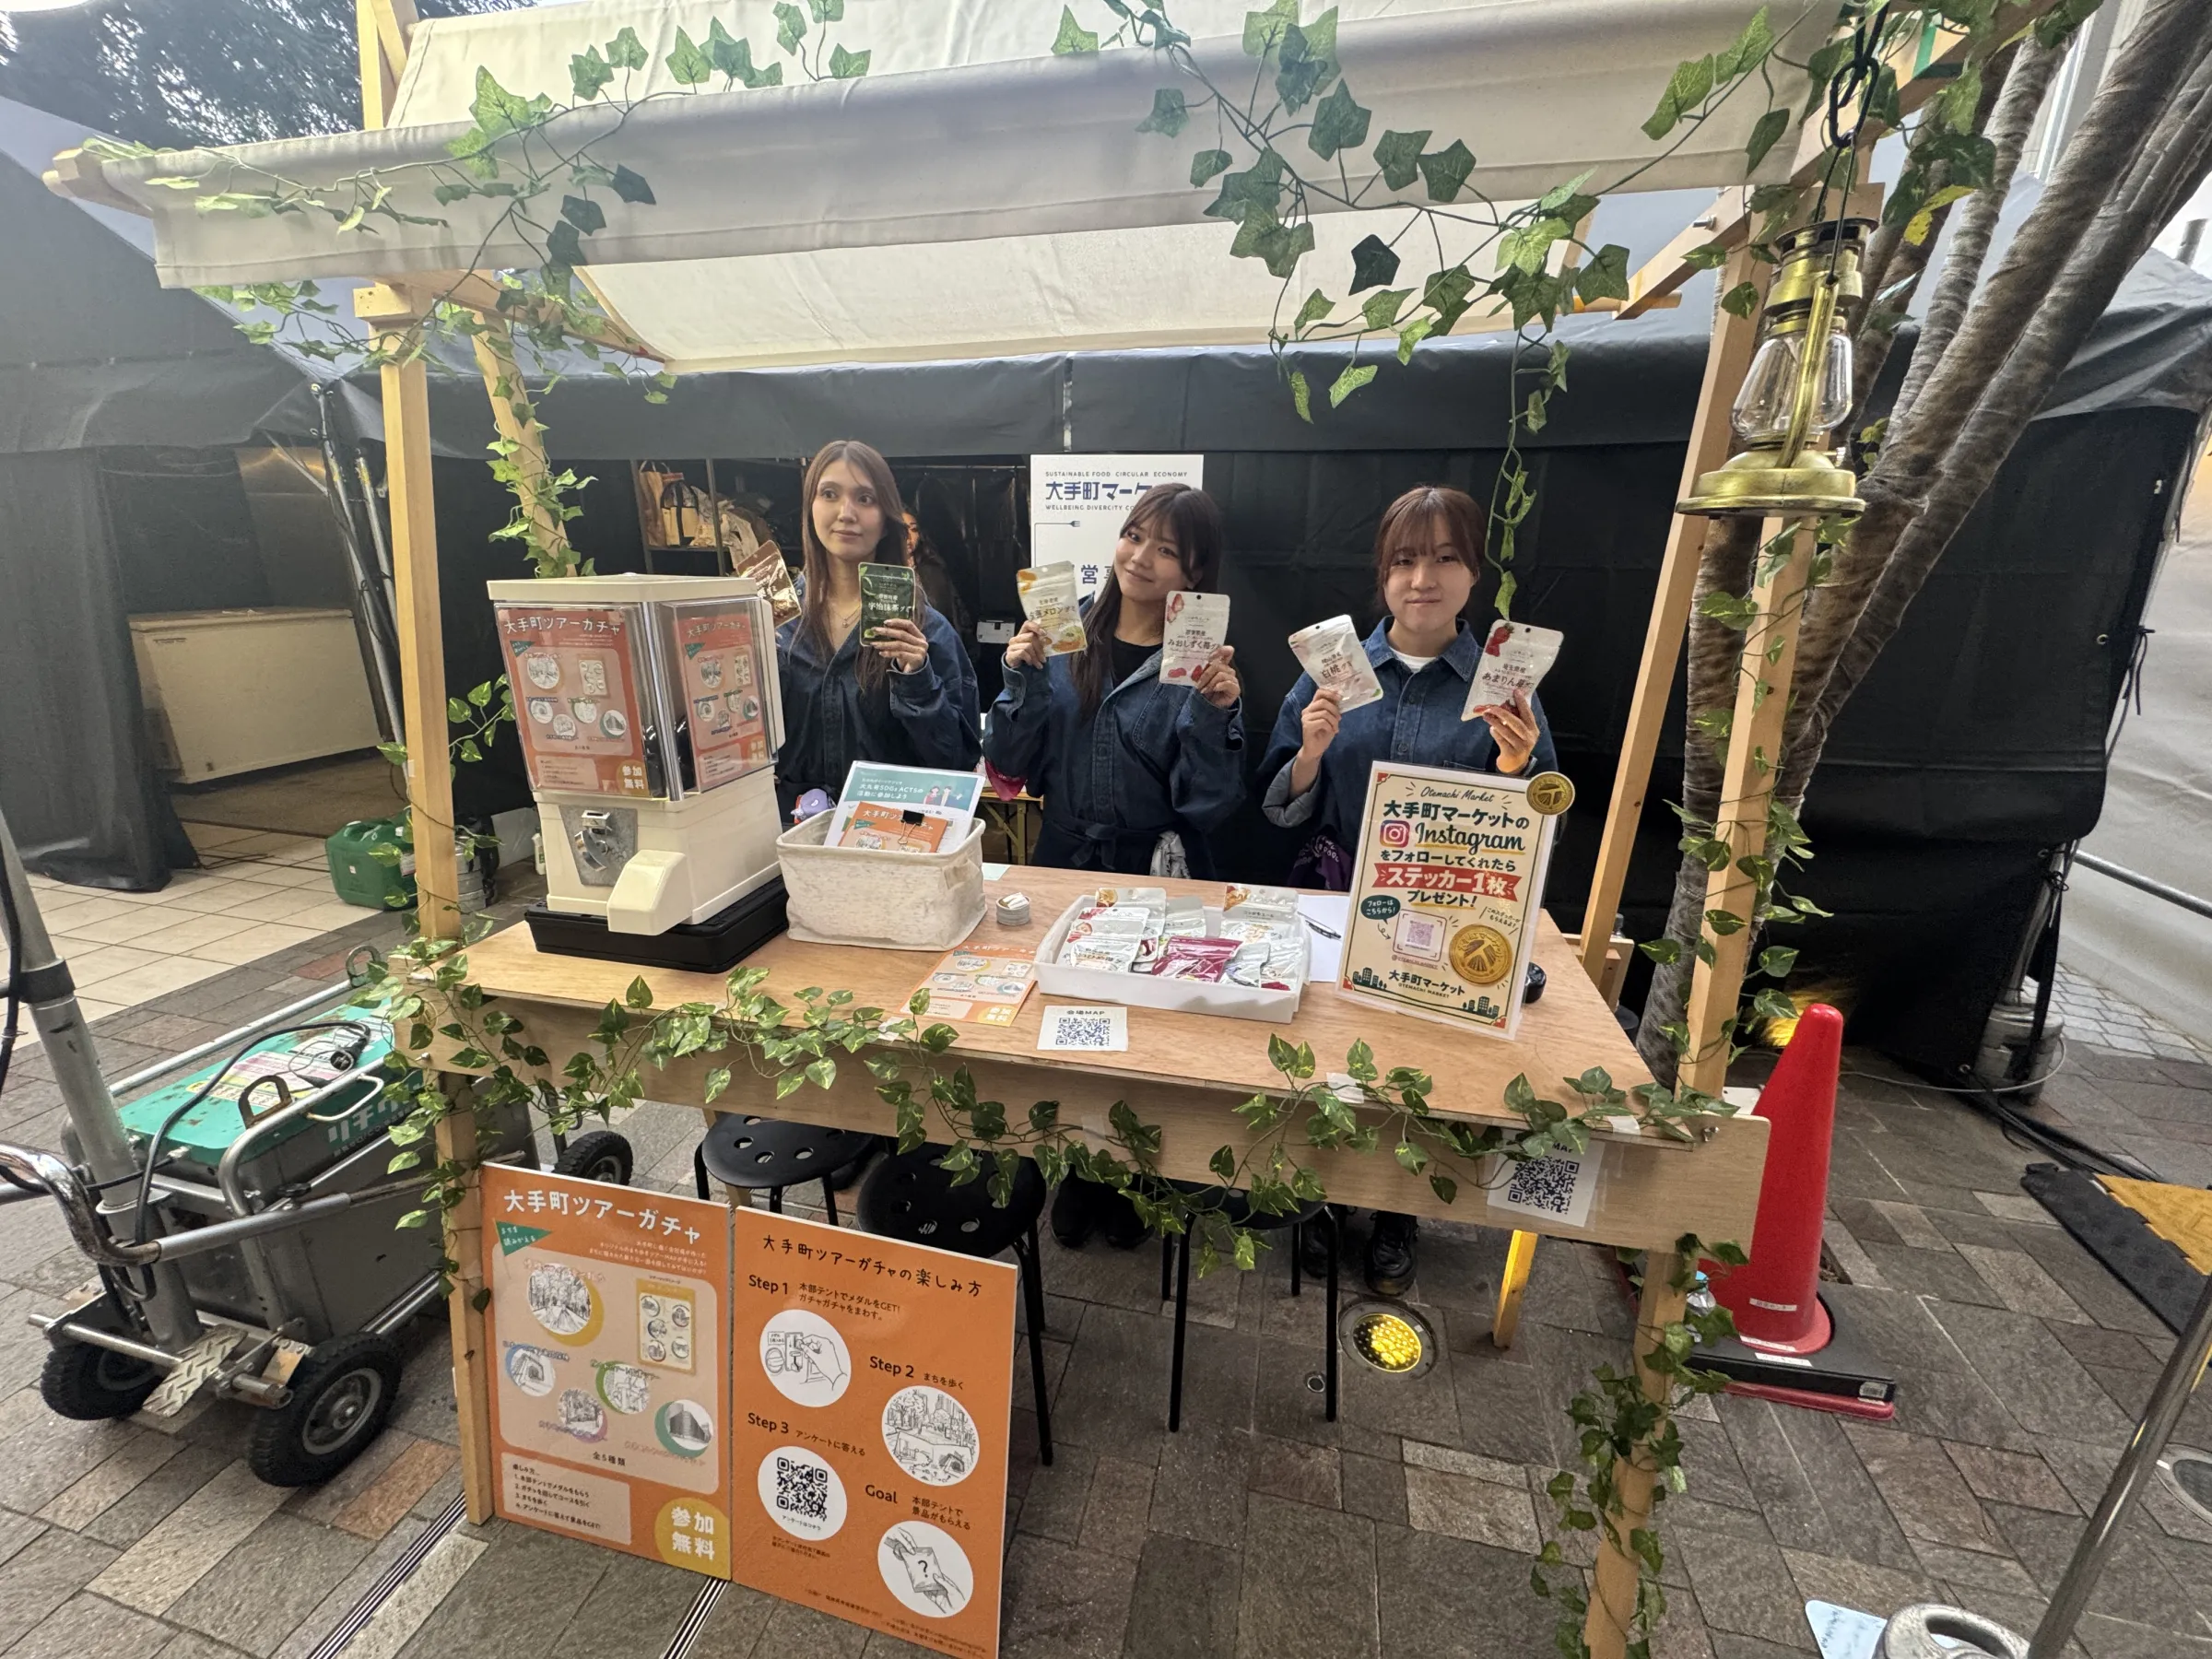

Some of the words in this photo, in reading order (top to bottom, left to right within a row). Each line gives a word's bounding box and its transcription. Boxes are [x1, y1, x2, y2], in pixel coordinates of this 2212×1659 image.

[1420, 786, 1460, 800] Otemachi
[1461, 790, 1495, 803] Market
[1382, 799, 1530, 830] 大手町マーケットの
[1415, 821, 1526, 855] Instagram
[1381, 849, 1516, 872] をフォローしてくれたら
[1386, 865, 1507, 895] ステッカー1枚
[1407, 889, 1477, 908] プレゼント!
[1389, 970, 1465, 996] 大手町マーケット
[1398, 983, 1426, 994] OTEMACHI
[1428, 990, 1450, 999] MARKET
[504, 1190, 701, 1244] 大手町ツアーガチャ
[763, 1234, 982, 1297] 大手町ツアーガチャの楽しみ方
[748, 1274, 779, 1294] Step
[869, 1356, 902, 1378] Step
[905, 1365, 914, 1379] 2
[924, 1372, 964, 1391] まちを歩く
[747, 1412, 778, 1432] Step
[781, 1422, 790, 1435] 3
[795, 1430, 866, 1457] アンケートに答える
[593, 1451, 626, 1466] 全5種類
[865, 1484, 899, 1505] Goal
[912, 1494, 963, 1517] 本部テントで
[671, 1506, 714, 1535] 参加
[912, 1507, 971, 1530] 景品がもらえる
[672, 1531, 715, 1560] 無料
